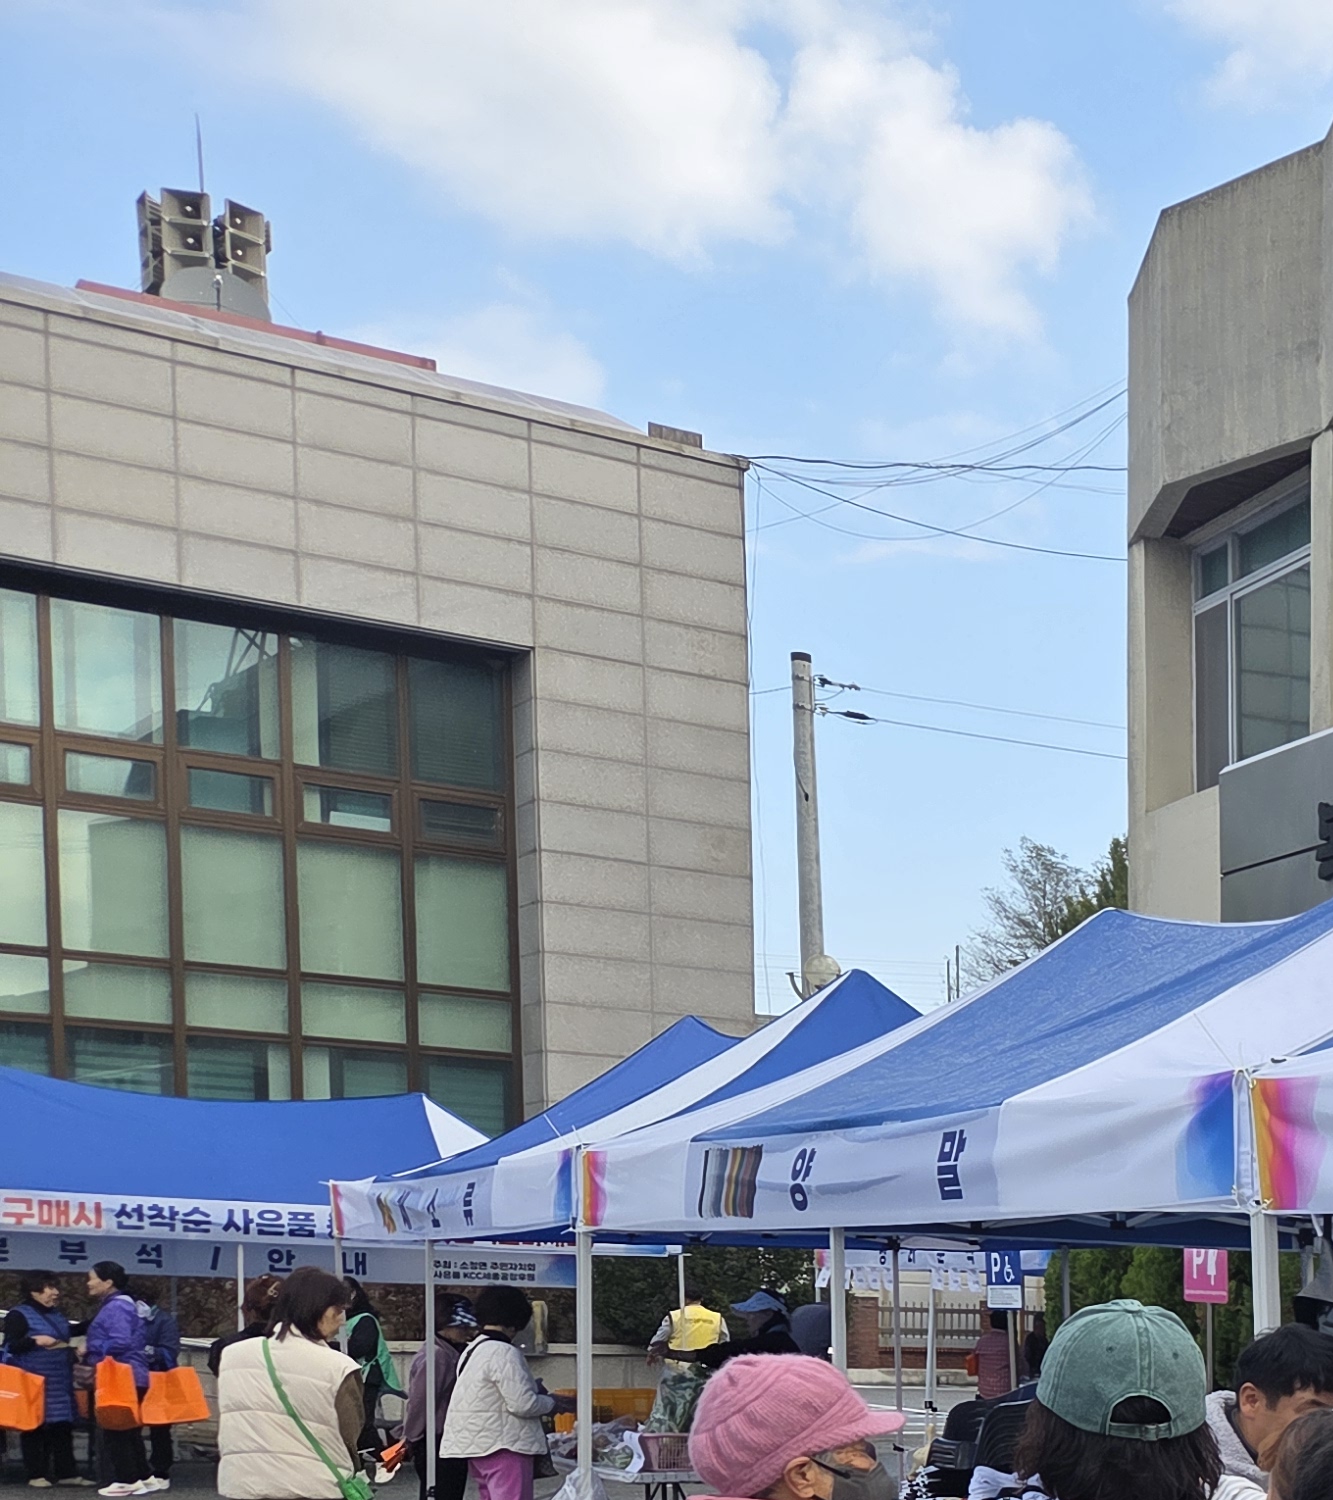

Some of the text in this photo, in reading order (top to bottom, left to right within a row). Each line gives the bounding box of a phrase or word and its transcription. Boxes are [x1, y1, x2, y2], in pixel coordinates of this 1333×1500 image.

[2, 1196, 103, 1230] 구매시
[113, 1202, 212, 1234] 선착순
[222, 1207, 316, 1239] 사은품
[991, 1252, 1001, 1282] P
[1192, 1249, 1205, 1279] P
